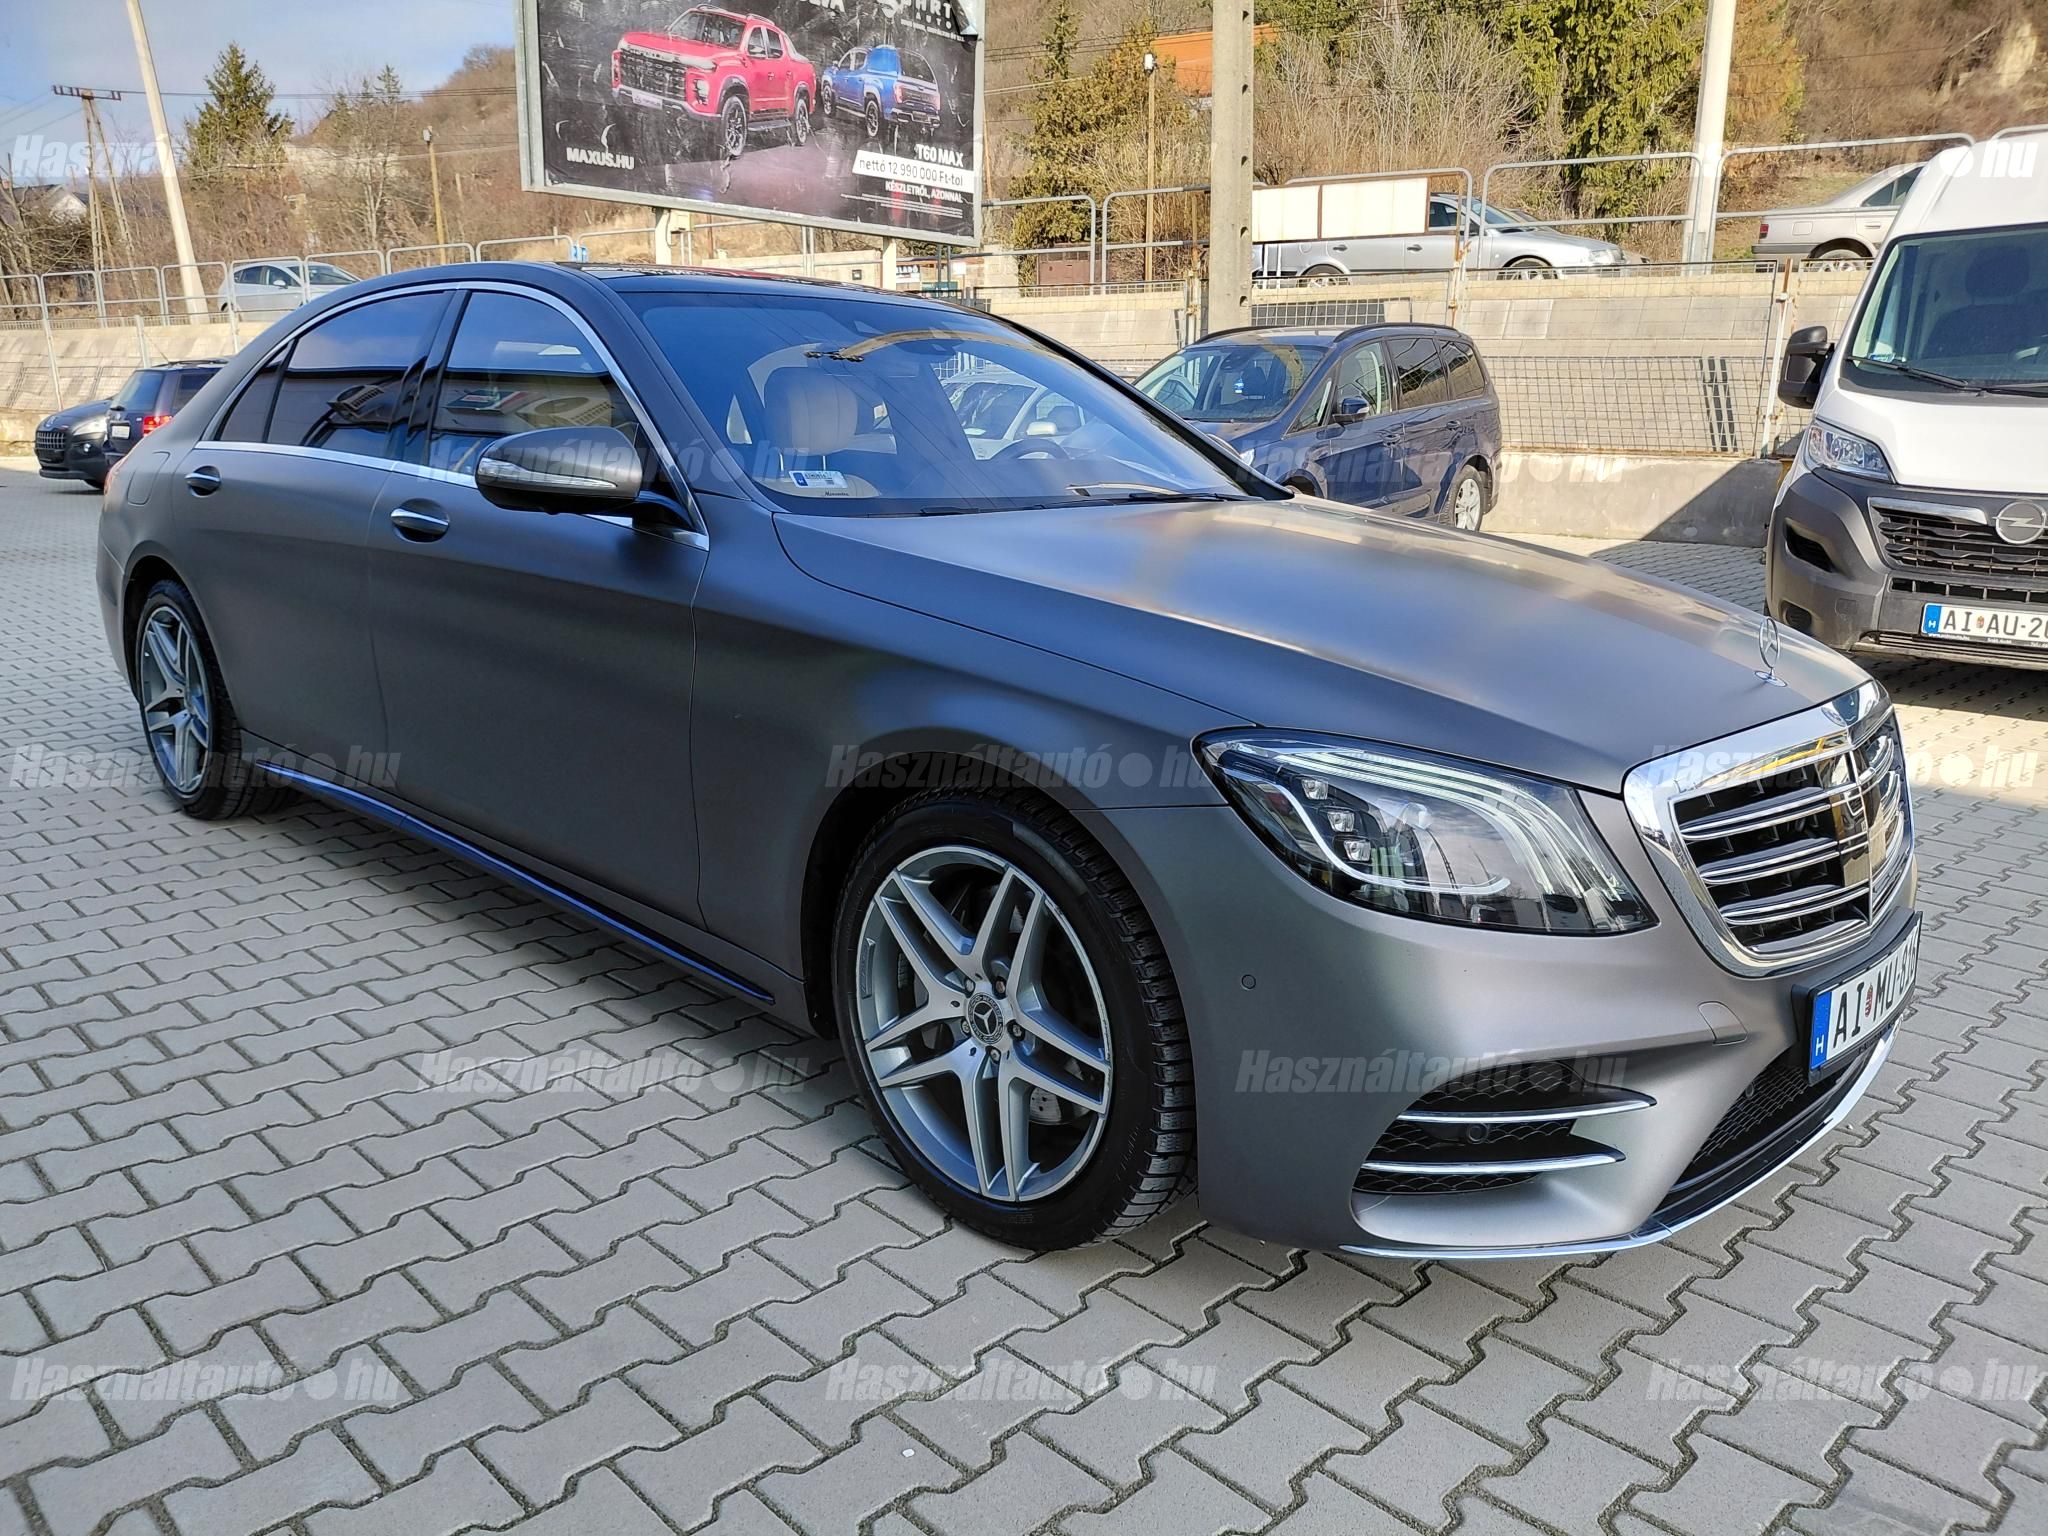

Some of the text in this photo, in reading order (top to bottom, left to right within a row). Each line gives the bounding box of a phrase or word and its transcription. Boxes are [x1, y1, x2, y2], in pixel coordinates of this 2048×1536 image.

[915, 12, 951, 29] AUTO
[566, 147, 634, 169] MAXUS.HU
[916, 144, 964, 167] T60 MAX
[859, 158, 886, 172] nettó
[888, 162, 898, 175] 12
[900, 164, 918, 178] 990
[919, 167, 937, 181] 000
[931, 186, 964, 203] AZONNAL
[1928, 620, 1936, 629] H
[1943, 610, 1972, 632] AI
[1815, 1034, 1825, 1056] H
[1833, 981, 1865, 1048] AI
